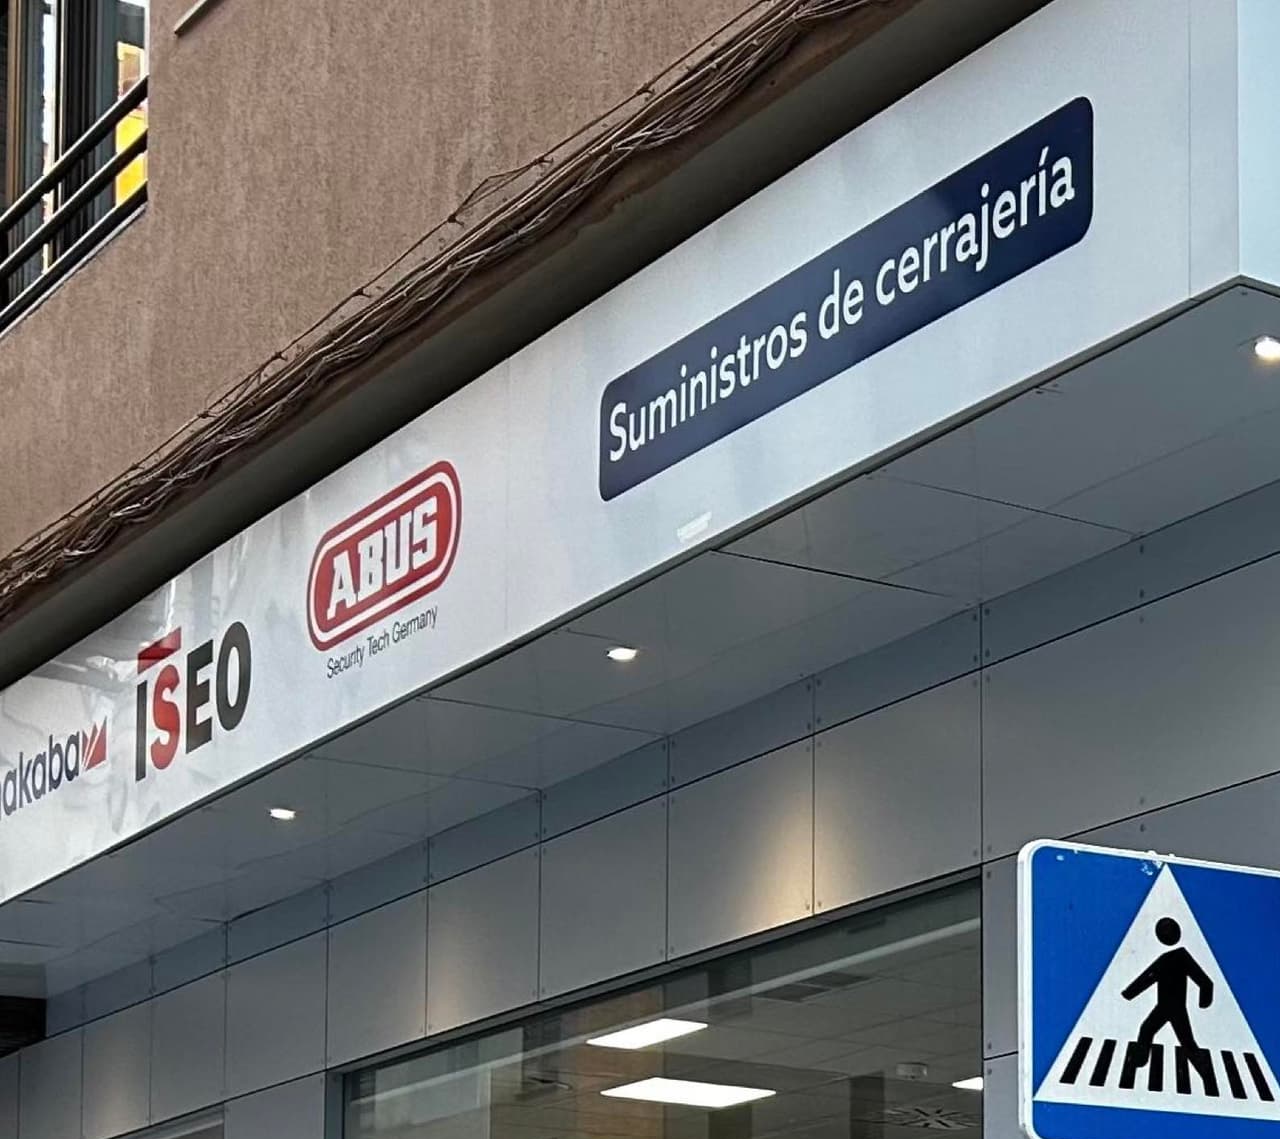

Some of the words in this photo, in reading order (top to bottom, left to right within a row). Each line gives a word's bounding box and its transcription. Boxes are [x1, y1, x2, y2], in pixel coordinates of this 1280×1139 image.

[609, 311, 807, 463] Suministros
[819, 268, 864, 340] de
[876, 147, 1075, 306] cerrajería
[327, 496, 438, 620] ABUS
[136, 621, 252, 782] ISEO
[327, 645, 364, 679] Security
[367, 629, 390, 657] Tech
[392, 606, 438, 643] Germany
[0, 731, 80, 818] akaba
